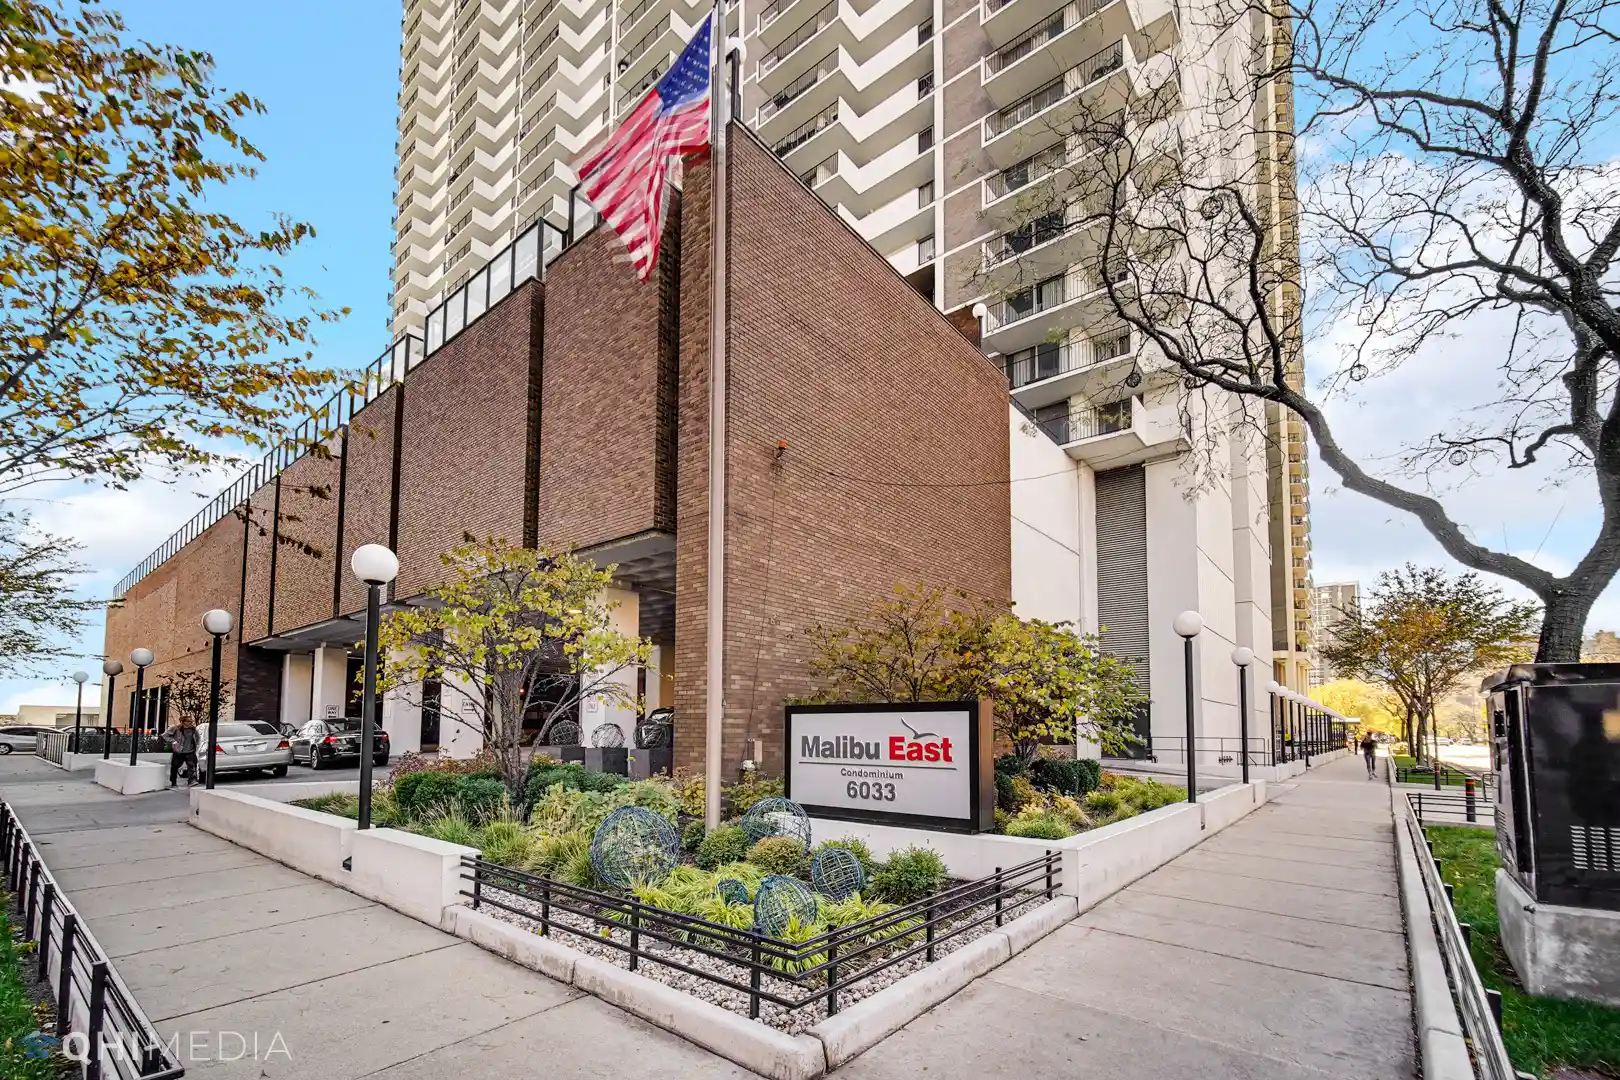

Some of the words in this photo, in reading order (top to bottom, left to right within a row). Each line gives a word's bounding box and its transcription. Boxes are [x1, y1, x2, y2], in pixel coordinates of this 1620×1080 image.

[801, 735, 881, 760] Malibu
[889, 736, 953, 762] East
[840, 768, 904, 780] Condominium
[846, 781, 896, 801] 6033
